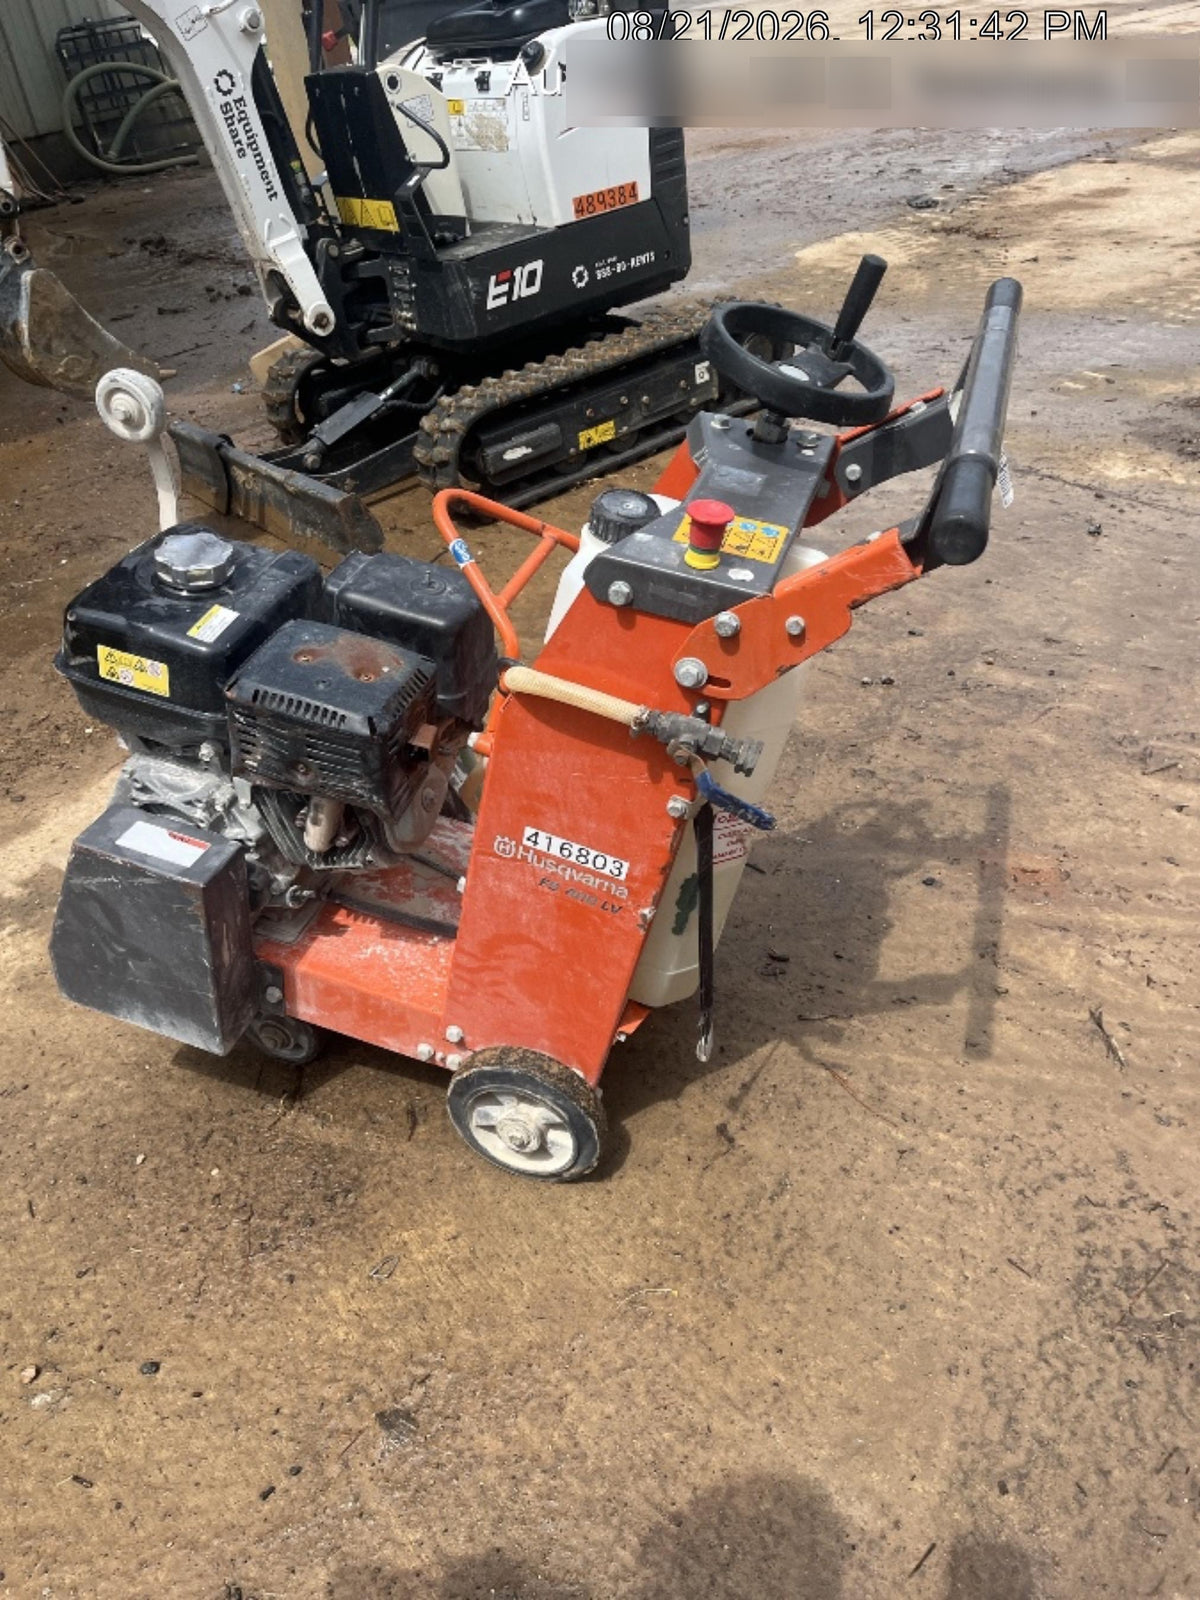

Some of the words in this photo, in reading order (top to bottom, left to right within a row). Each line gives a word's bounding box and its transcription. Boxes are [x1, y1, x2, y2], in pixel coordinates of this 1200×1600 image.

[220, 101, 246, 159] Share
[232, 96, 278, 201] Equipment
[574, 181, 638, 216] 489384
[487, 259, 544, 310] E10
[517, 845, 629, 900] Husqvarna
[525, 831, 624, 877] 416803
